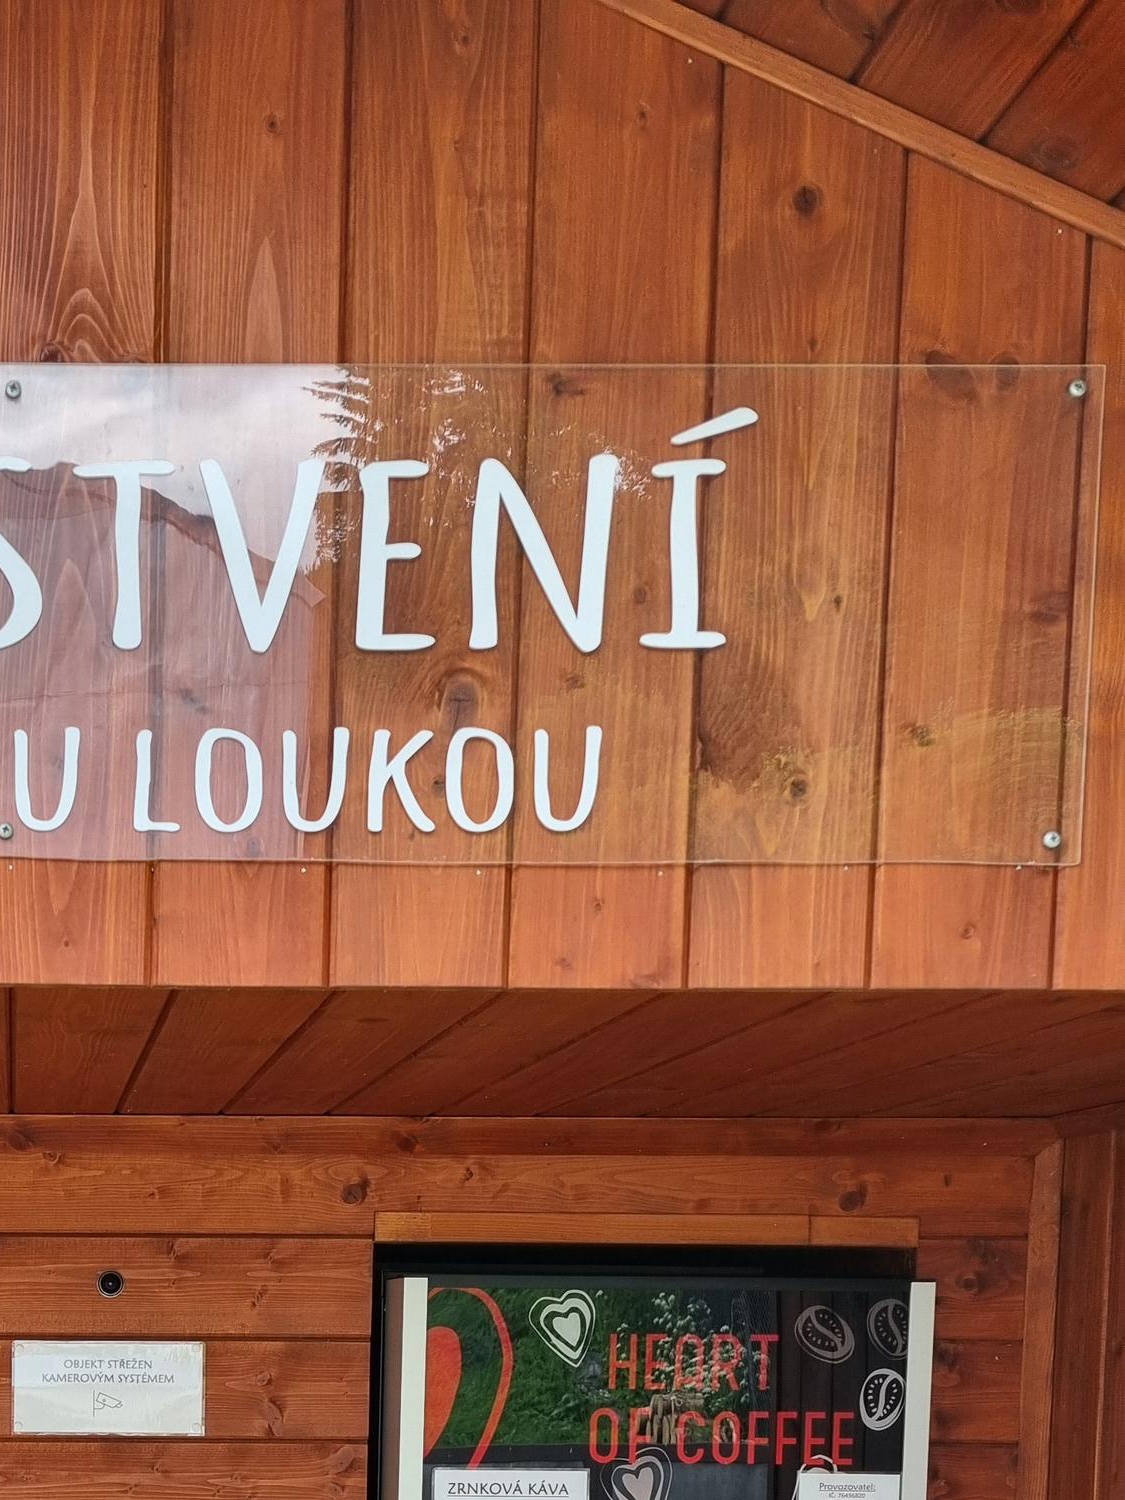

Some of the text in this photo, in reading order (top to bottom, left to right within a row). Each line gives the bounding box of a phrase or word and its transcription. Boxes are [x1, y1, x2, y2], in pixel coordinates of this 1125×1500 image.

[135, 724, 603, 834] LOUKOU
[64, 1357, 153, 1369] OBJEKT STŘEŽEN
[607, 1333, 779, 1391] HEART
[42, 1371, 175, 1384] KAMEROVÝM SYSTÉMEM
[589, 1407, 855, 1466] OF COFFEE
[447, 1480, 569, 1497] ZRNKOVÁ KÁVA
[819, 1482, 875, 1493] Provozovatel:
